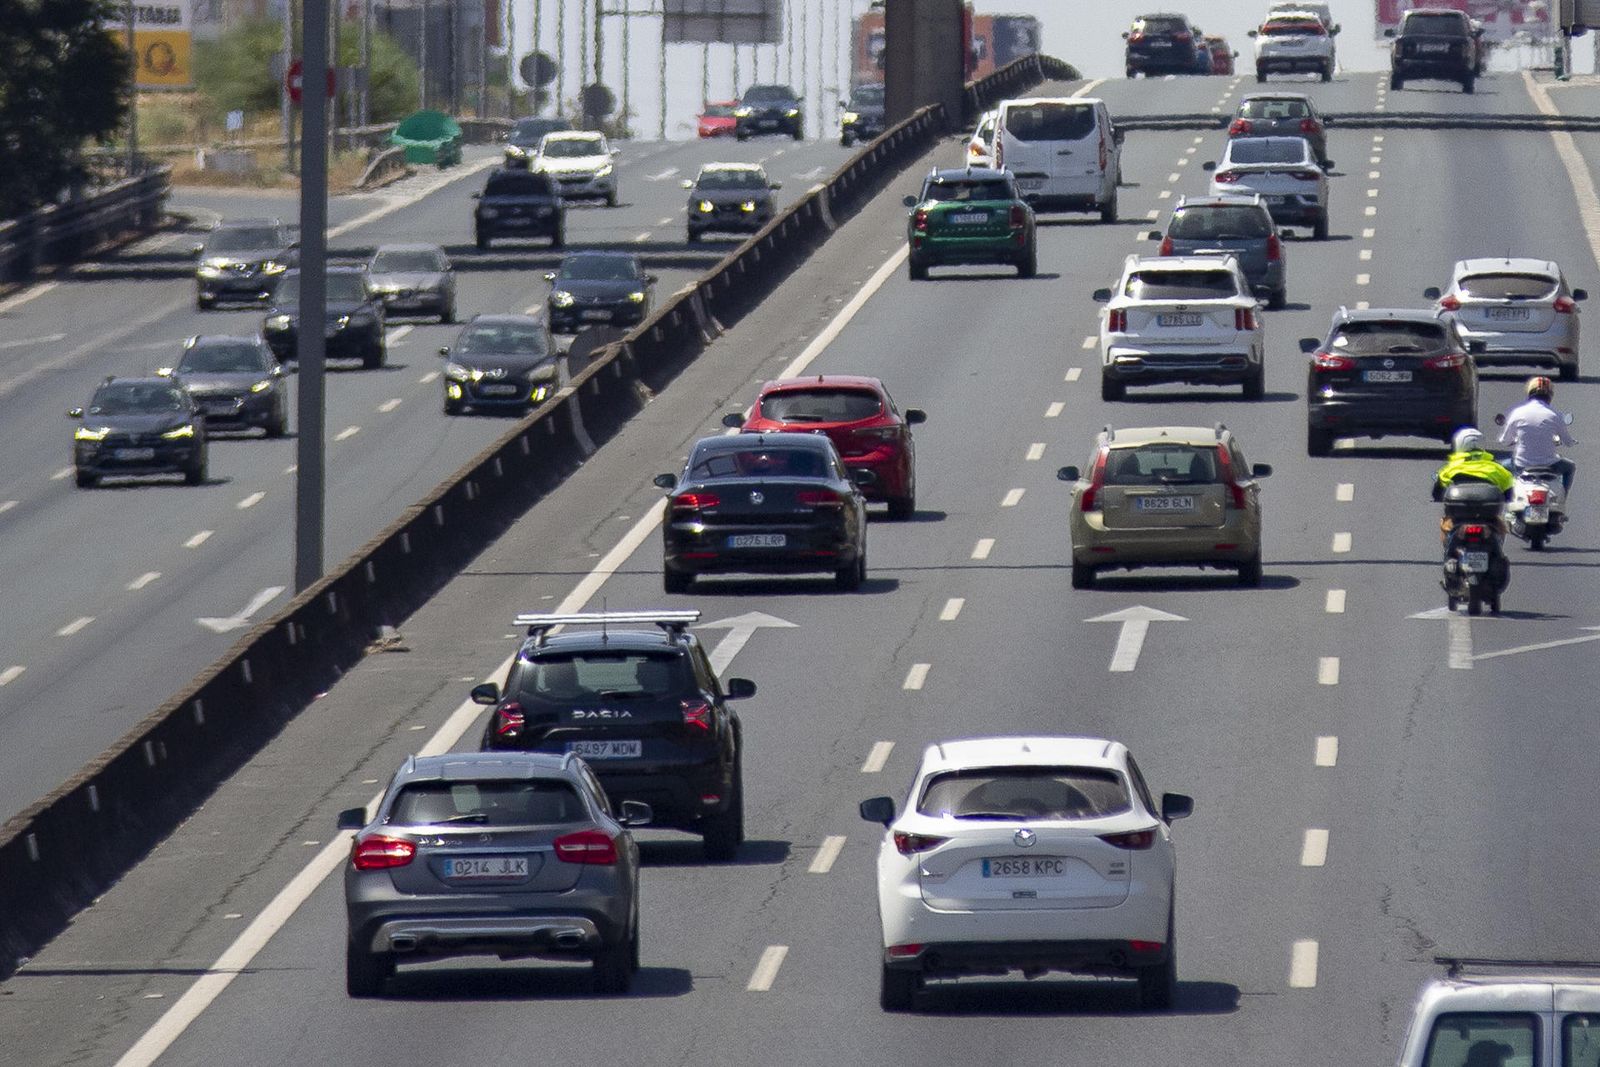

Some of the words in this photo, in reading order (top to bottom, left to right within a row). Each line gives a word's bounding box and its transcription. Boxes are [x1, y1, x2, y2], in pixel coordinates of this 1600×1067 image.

[571, 710, 633, 719] DACIA
[455, 861, 489, 875] 0214
[500, 860, 525, 874] JLK
[993, 861, 1030, 875] 2658
[1034, 860, 1064, 874] KPC
